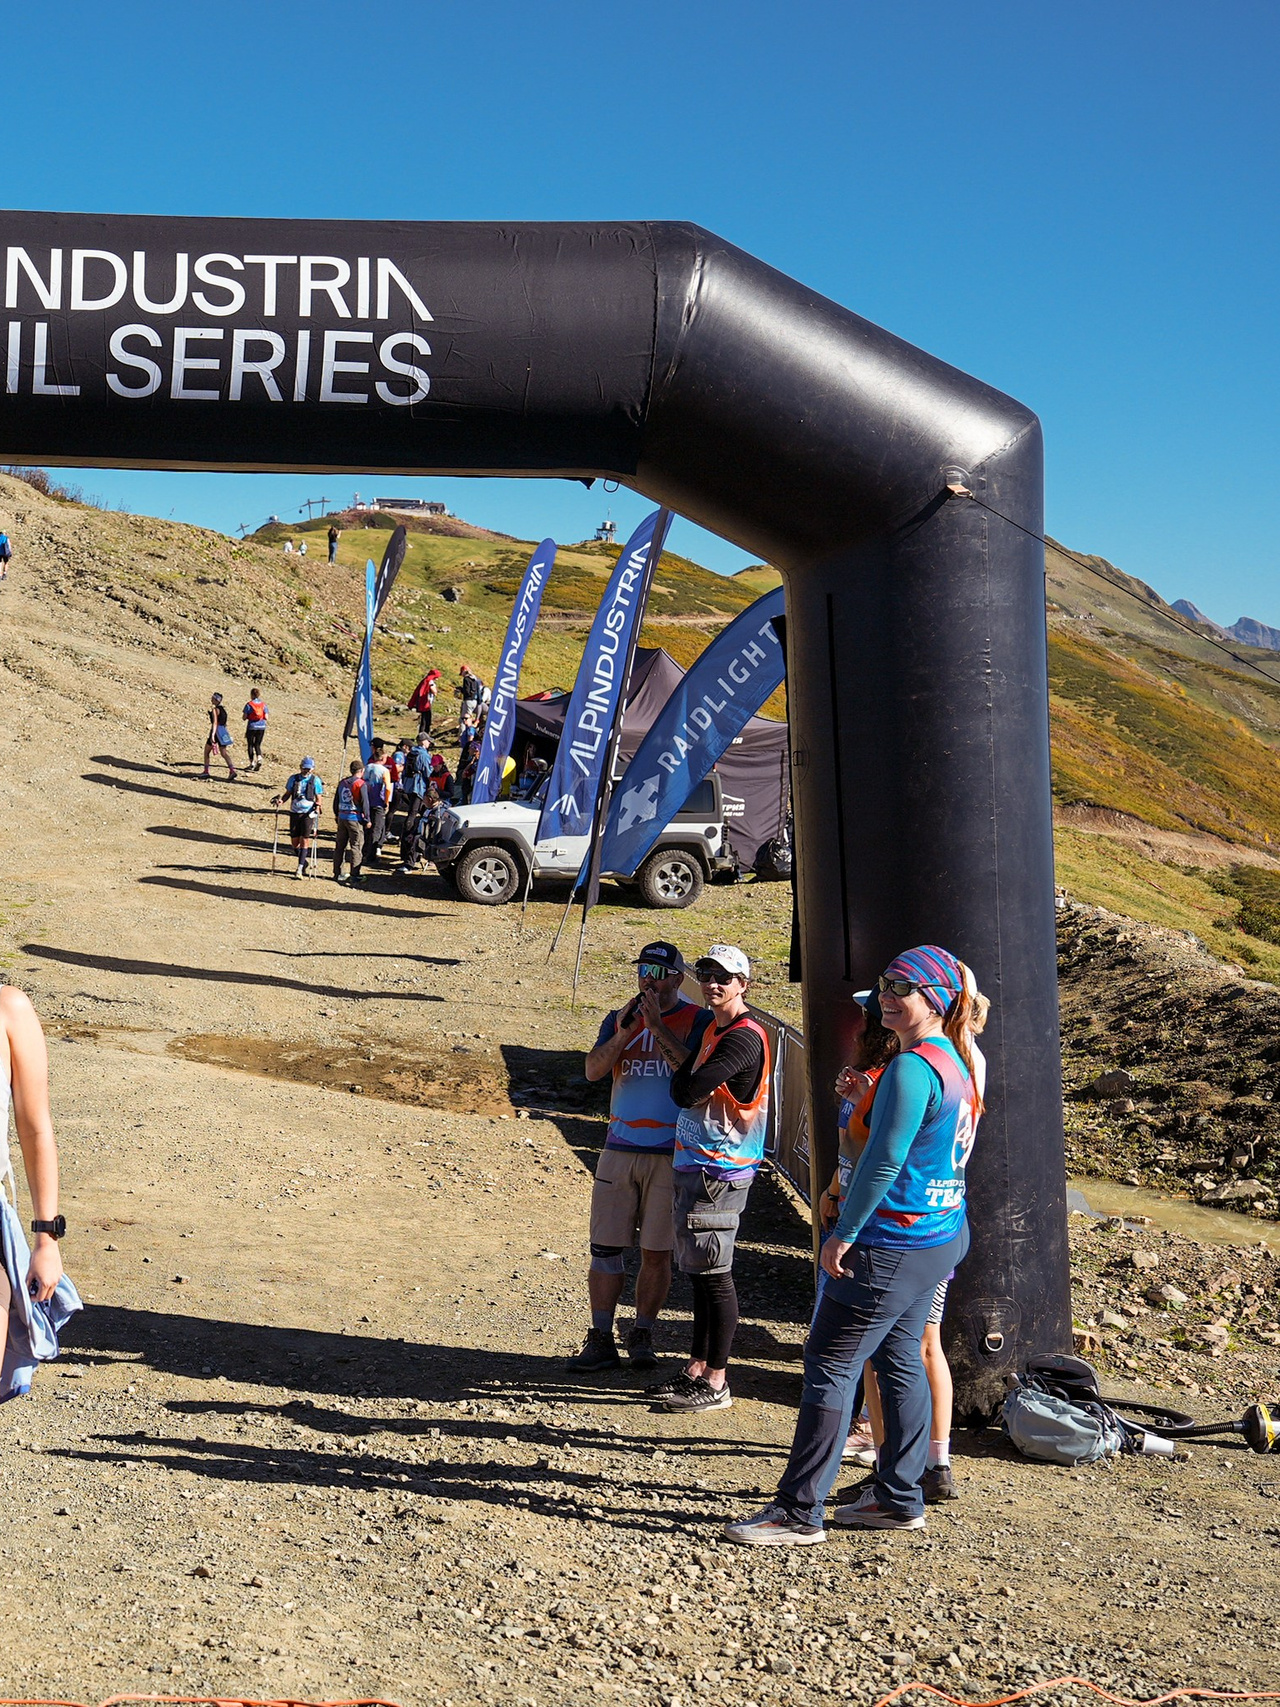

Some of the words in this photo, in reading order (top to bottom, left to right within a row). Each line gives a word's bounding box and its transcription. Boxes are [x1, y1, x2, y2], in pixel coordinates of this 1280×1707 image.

[105, 323, 433, 406] SERIES
[488, 562, 545, 751] ALPINDUSTRIA
[569, 541, 652, 777] ALPINDUSTRIA
[657, 621, 779, 774] RAIDLIGHT
[621, 1059, 672, 1077] CREW
